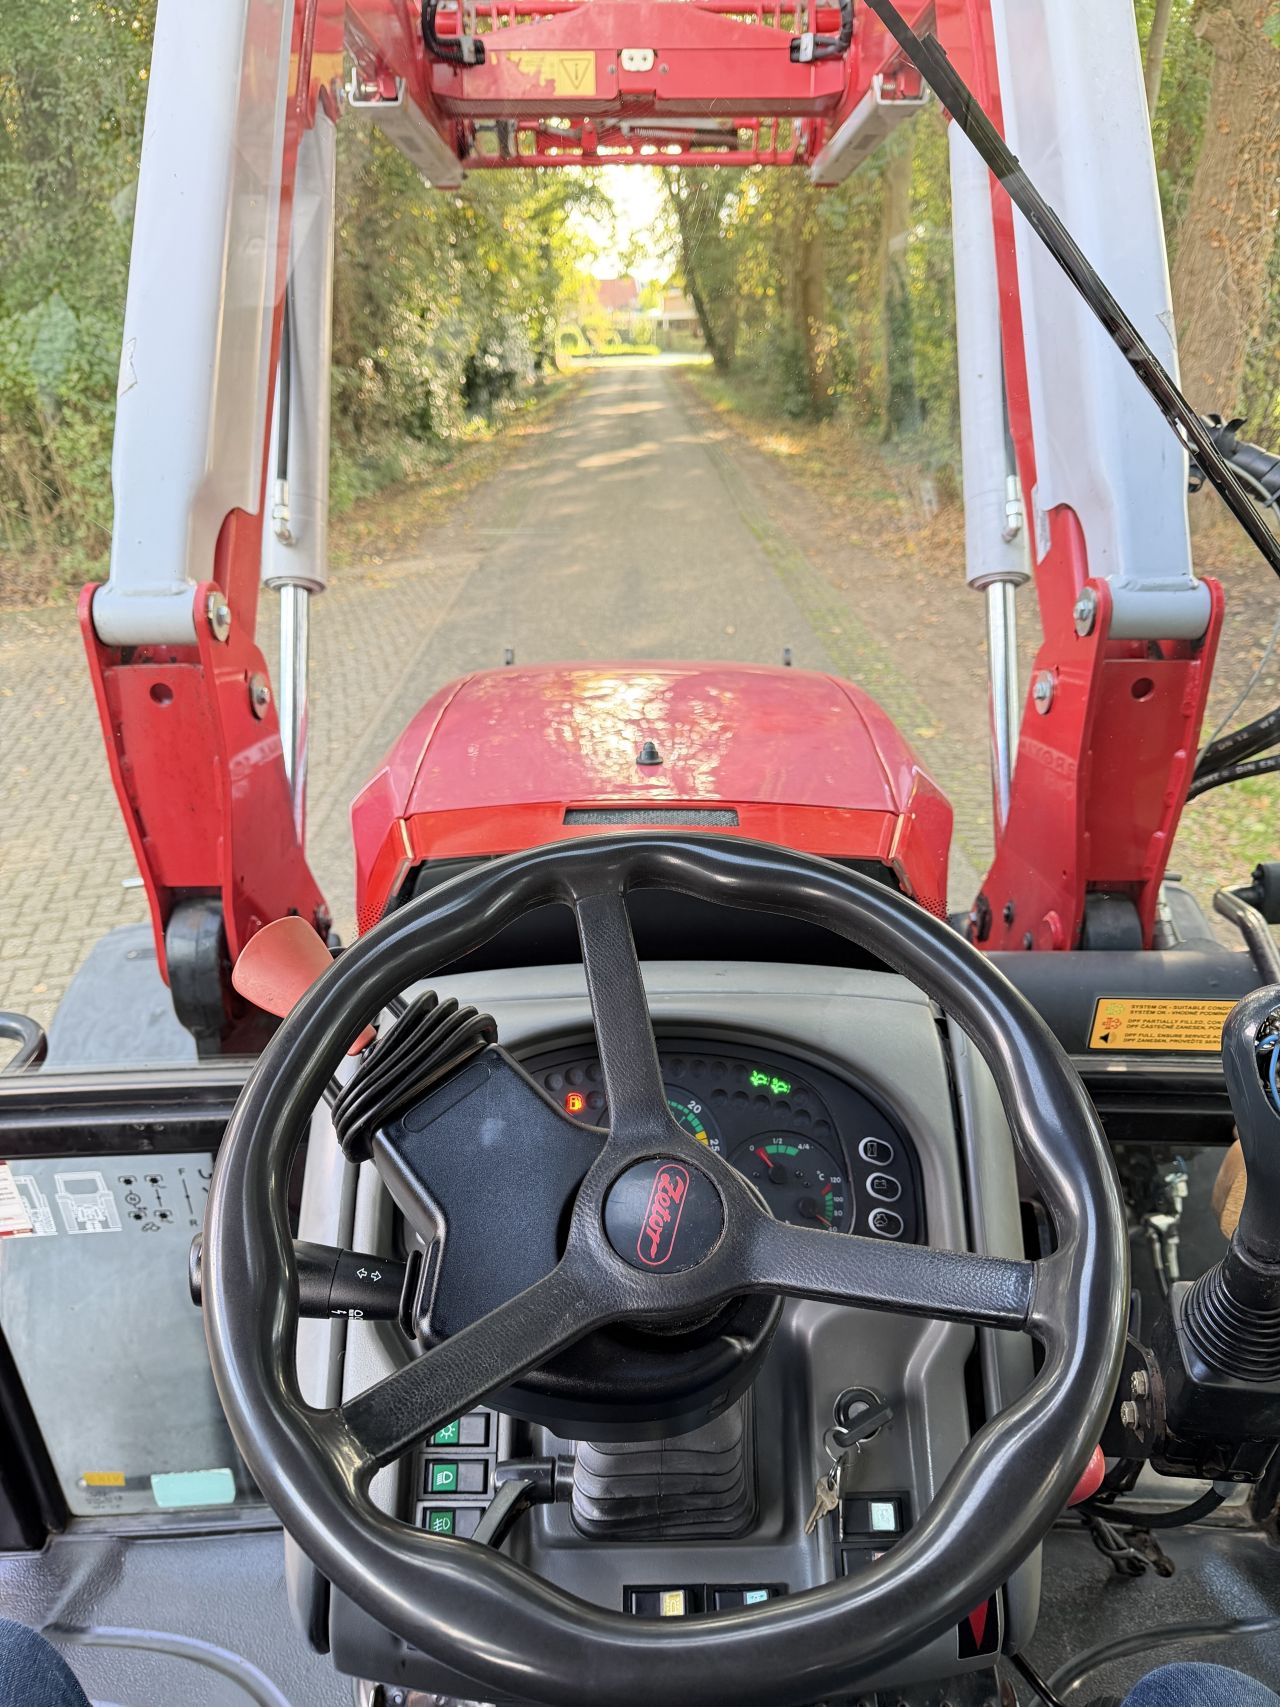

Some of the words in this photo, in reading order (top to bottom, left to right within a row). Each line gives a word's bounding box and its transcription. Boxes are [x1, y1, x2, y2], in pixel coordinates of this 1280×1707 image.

[687, 1100, 702, 1114] 20
[710, 1139, 720, 1153] 25
[646, 1173, 684, 1259] Zetor
